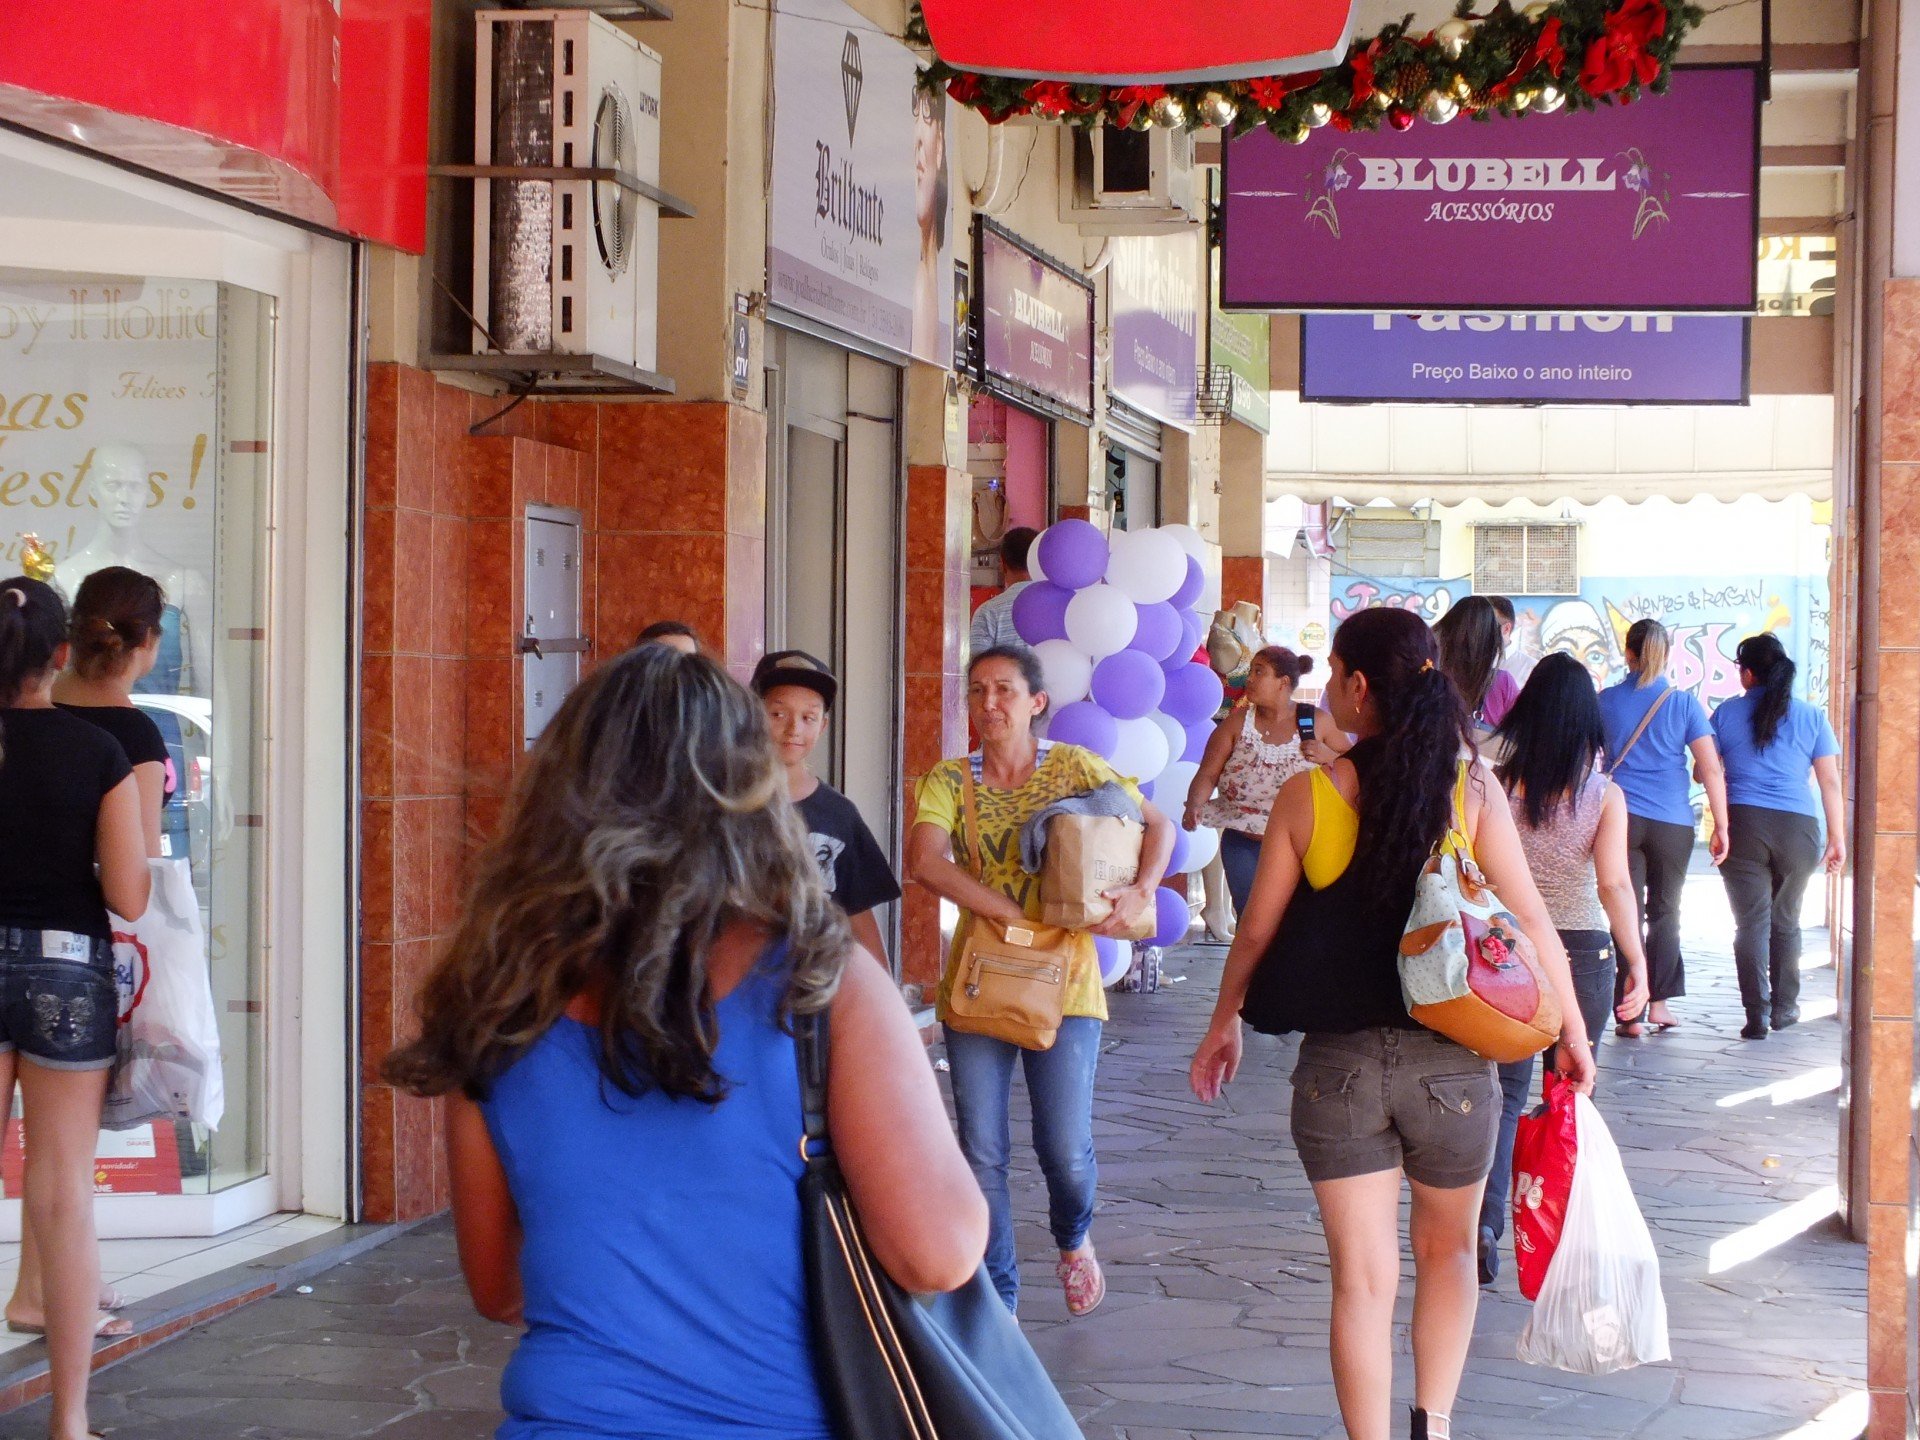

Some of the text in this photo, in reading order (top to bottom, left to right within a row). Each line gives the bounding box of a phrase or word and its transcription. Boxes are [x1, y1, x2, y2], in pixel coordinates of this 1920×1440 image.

[1358, 158, 1616, 192] BLUBELL
[814, 139, 884, 247] Brilhante
[1424, 197, 1554, 224] ACESSÓRIOS
[1014, 288, 1065, 342] BLUBELL
[112, 371, 187, 399] Felices
[1412, 363, 1632, 383] Preço Baixo o ano inteiro
[0, 392, 88, 431] as
